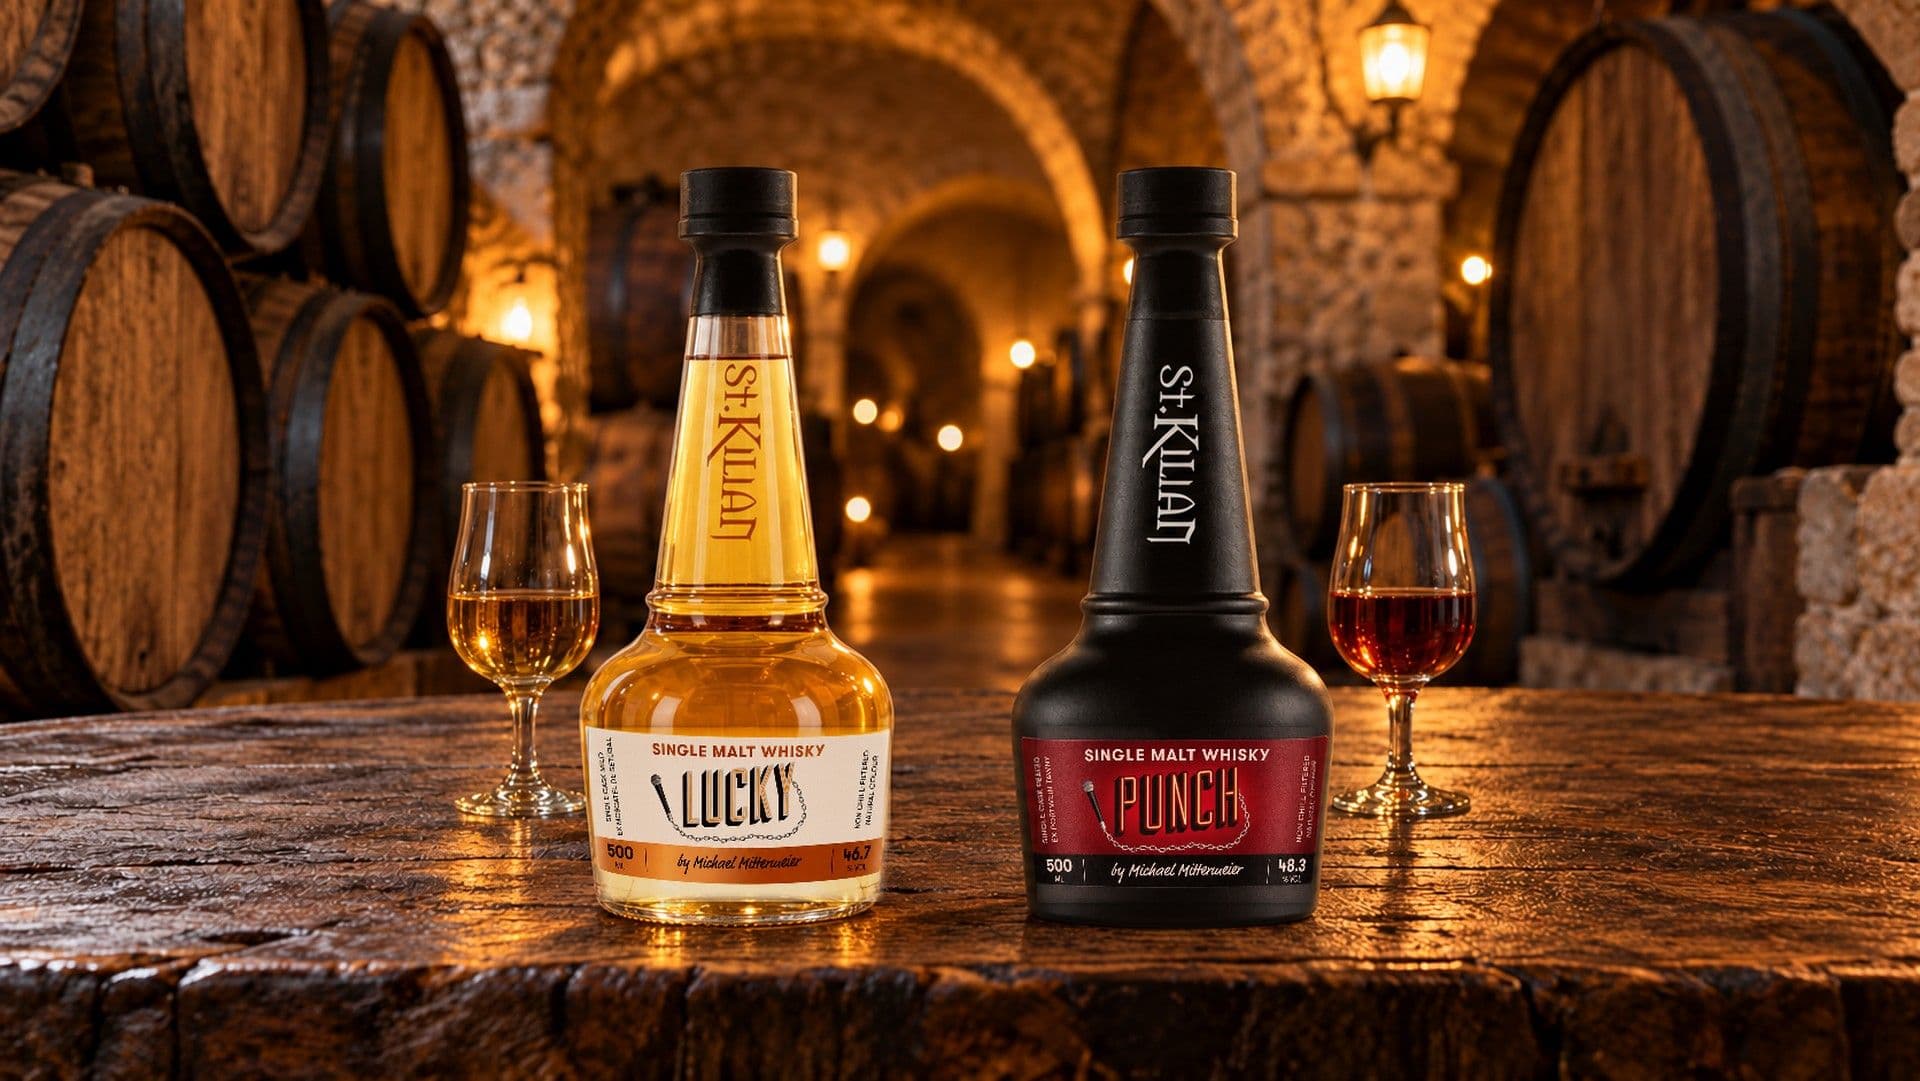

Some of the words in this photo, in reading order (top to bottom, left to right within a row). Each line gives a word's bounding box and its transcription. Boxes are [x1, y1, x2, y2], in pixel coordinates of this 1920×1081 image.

[652, 742, 707, 758] SINGLE
[712, 745, 756, 758] MALT
[761, 743, 826, 758] WHISKY
[1084, 748, 1145, 762] SINGLE
[1151, 748, 1197, 762] MALT
[1202, 748, 1270, 762] WHISKY
[682, 762, 796, 828] LUCKY
[1114, 767, 1239, 837] PUNCH
[854, 812, 862, 829] NON
[607, 843, 634, 860] 500
[843, 844, 872, 862] 46.7
[677, 853, 690, 875] by
[693, 854, 737, 870] Michael
[738, 855, 802, 871] Mittermeier
[1046, 858, 1072, 873] 500
[1278, 858, 1307, 873] 48.3
[1111, 862, 1124, 884] by
[1128, 863, 1175, 878] Michael
[1177, 862, 1244, 877] Mittermeier
